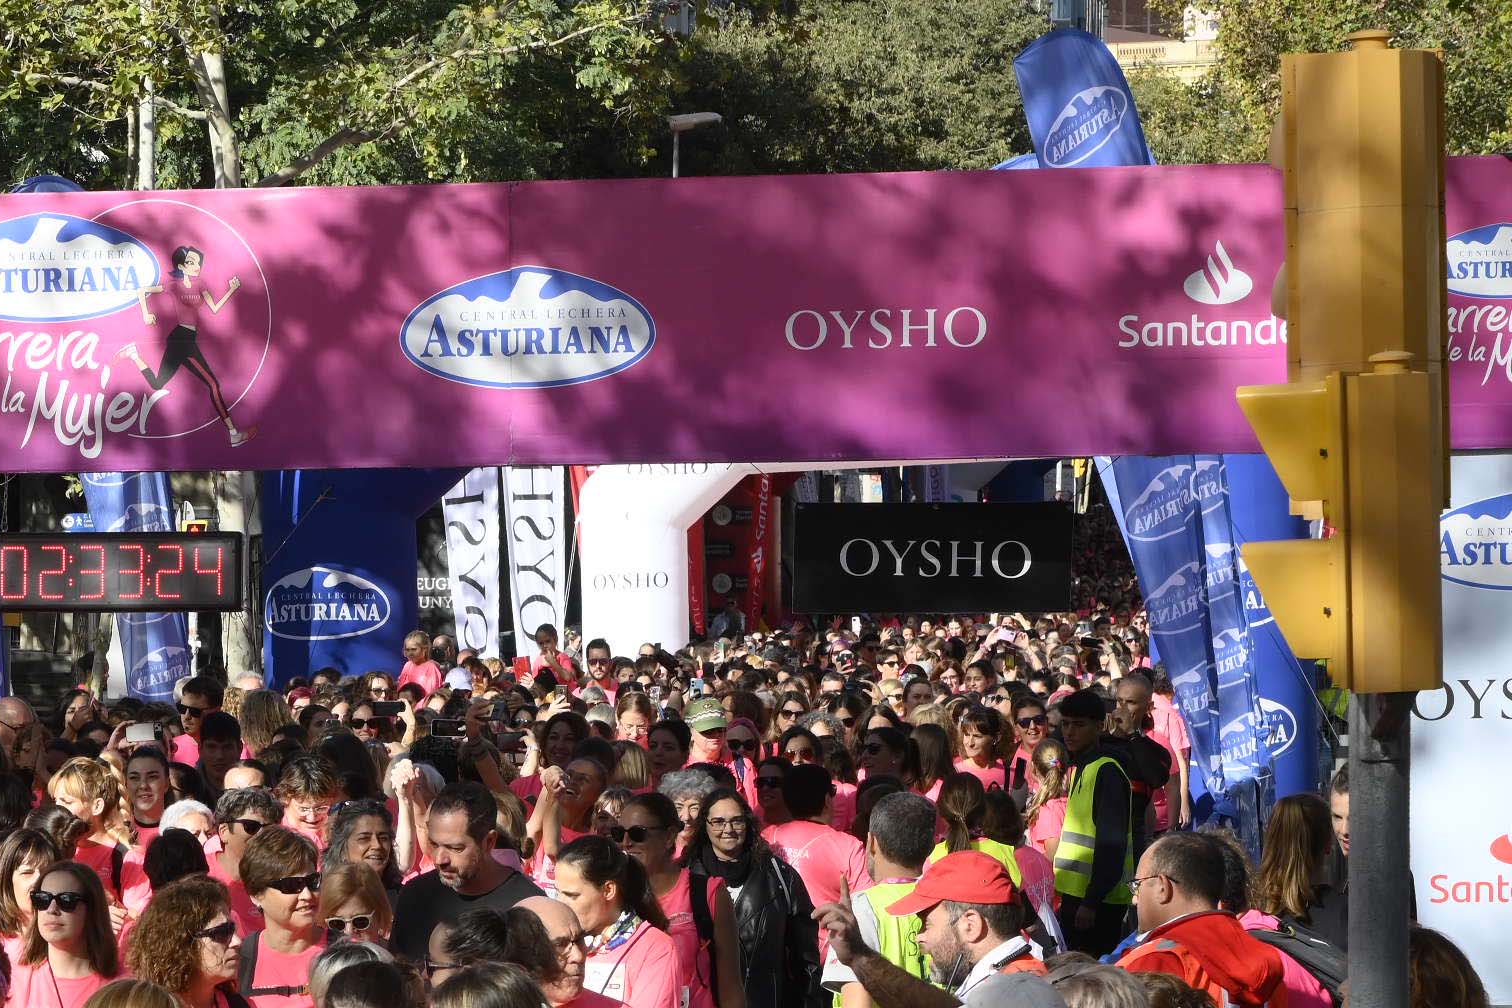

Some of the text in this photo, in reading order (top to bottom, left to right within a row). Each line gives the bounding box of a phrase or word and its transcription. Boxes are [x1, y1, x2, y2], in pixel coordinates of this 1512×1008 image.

[420, 313, 636, 358] ASTURIANA
[460, 307, 627, 322] CENTRAL LECHERA
[785, 306, 987, 350] OYSHO
[1468, 335, 1486, 362] la
[1, 375, 25, 413] la
[20, 364, 170, 459] Mujer
[756, 474, 769, 541] Santa
[0, 543, 224, 600] 02:33:24
[840, 538, 1032, 579] OYSHO
[593, 571, 669, 589] OYSHO
[269, 597, 380, 625] ASTURIANA
